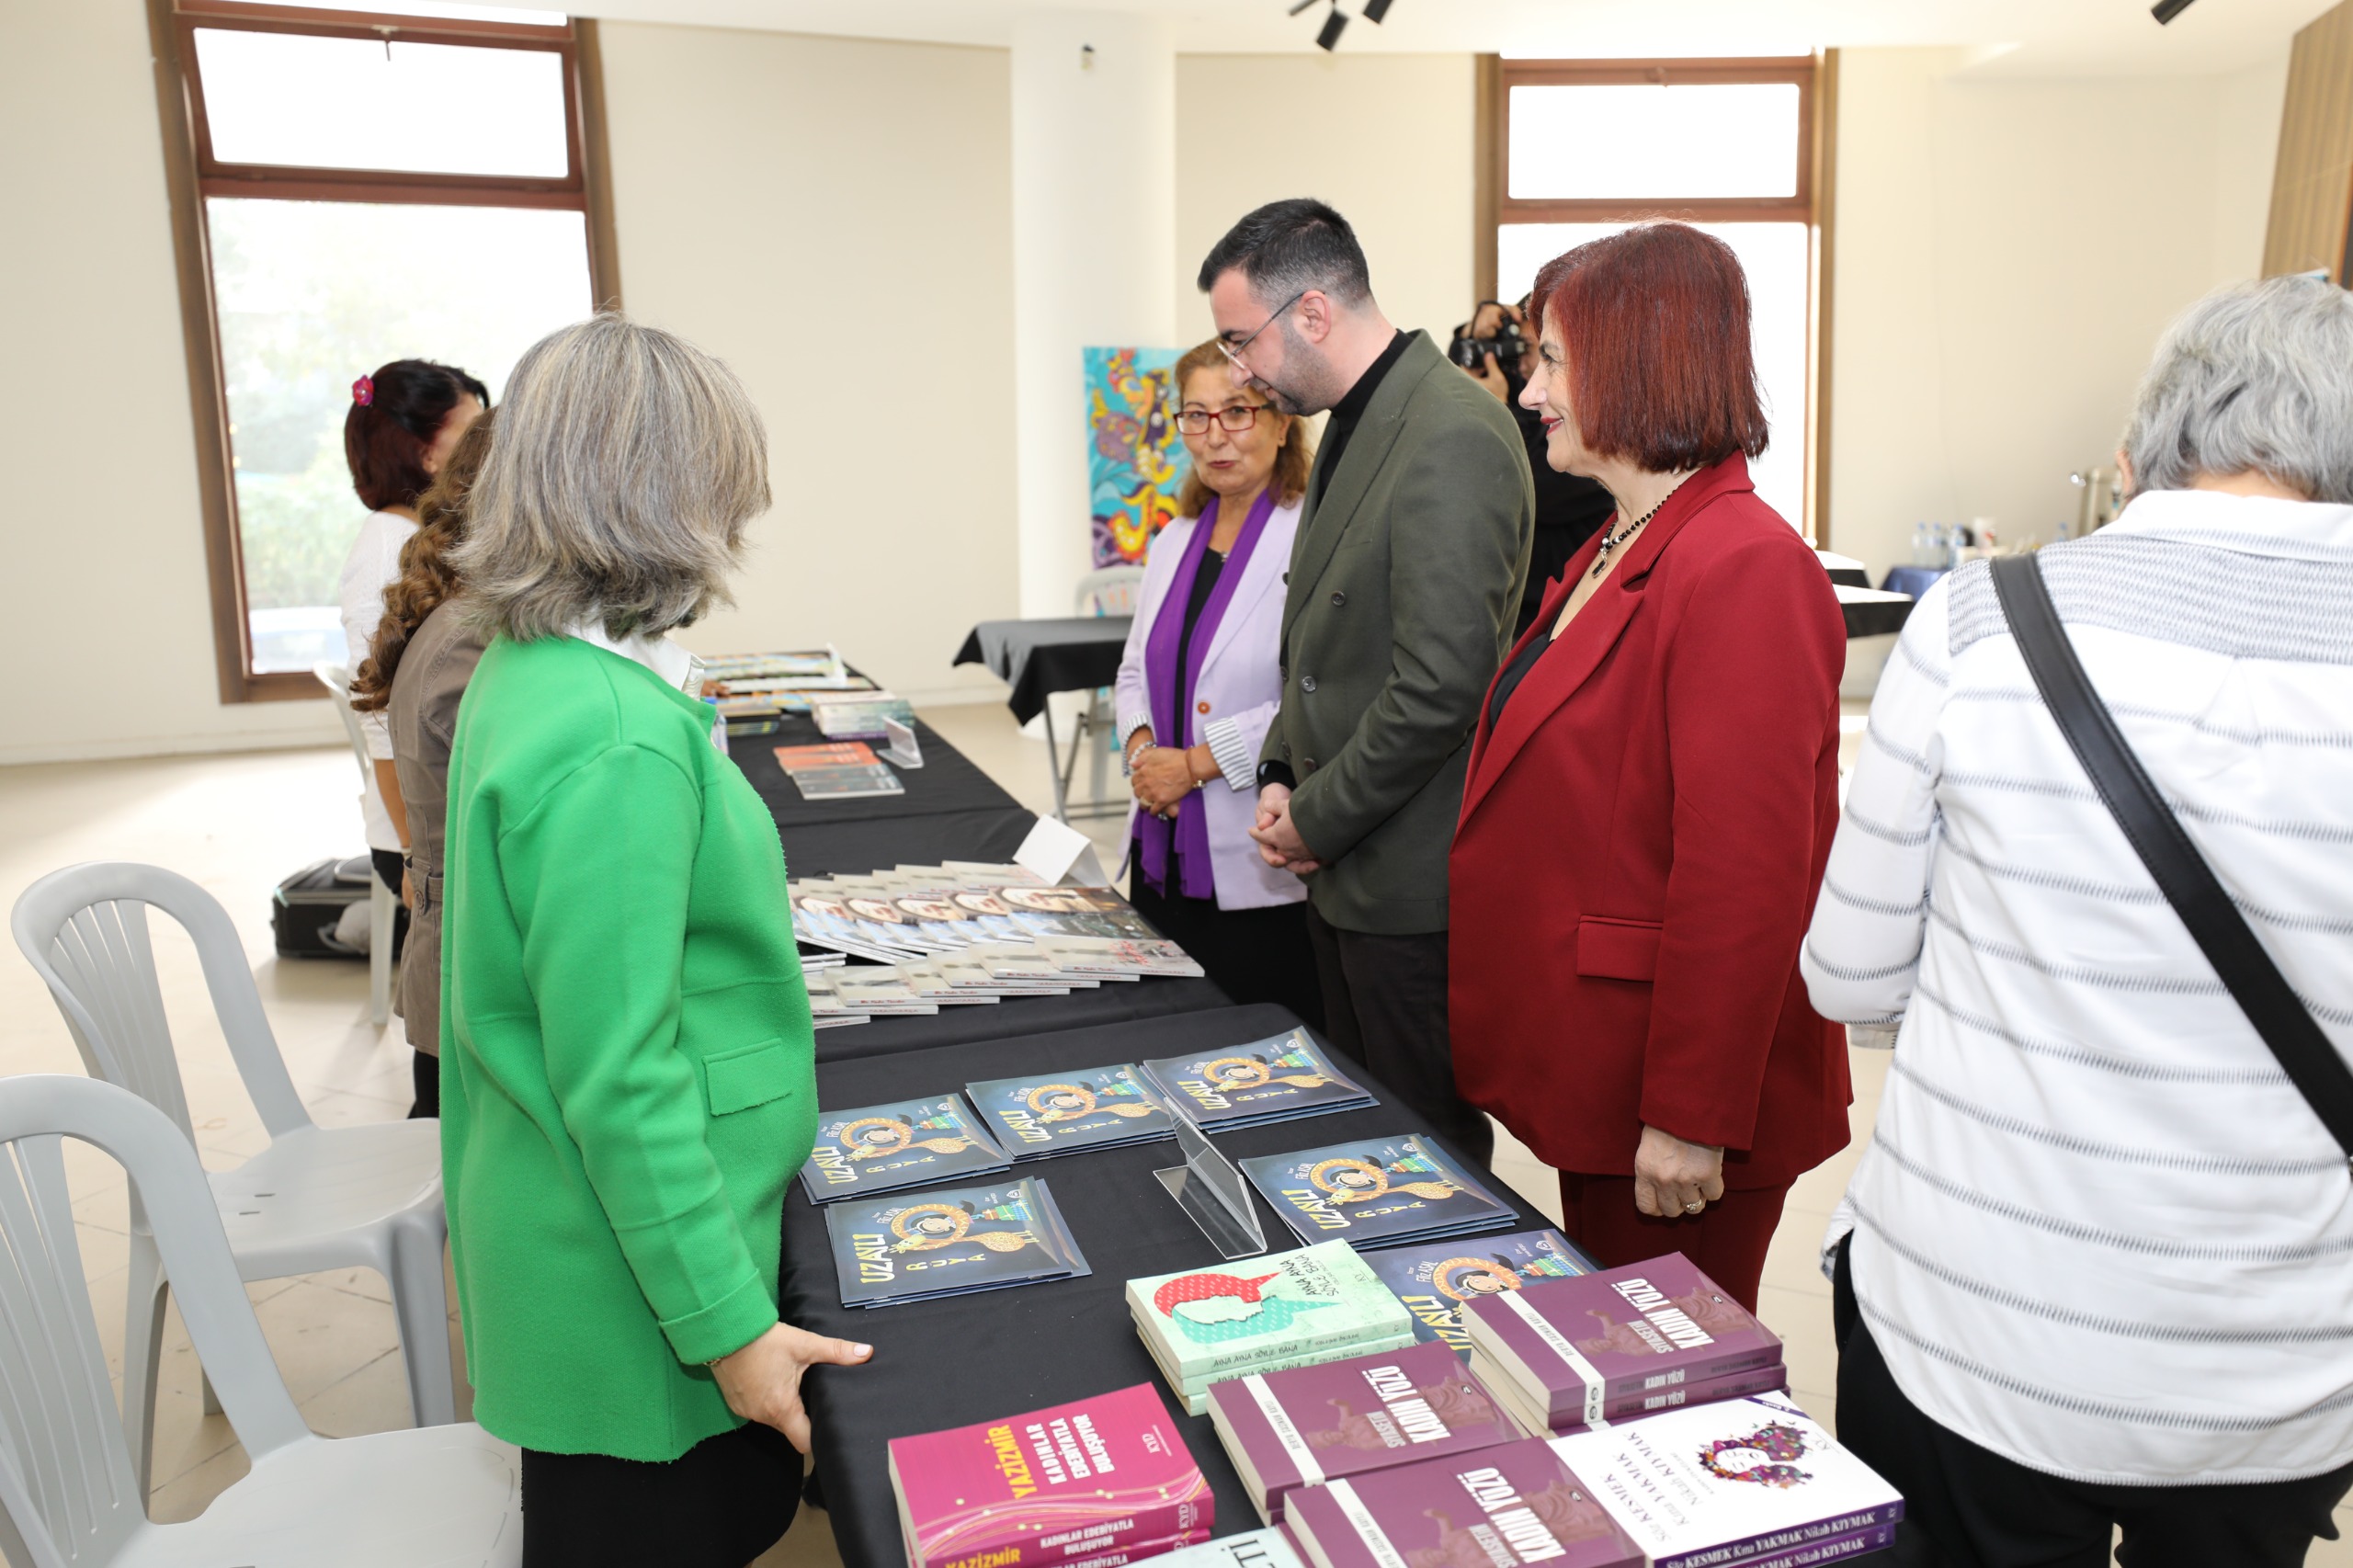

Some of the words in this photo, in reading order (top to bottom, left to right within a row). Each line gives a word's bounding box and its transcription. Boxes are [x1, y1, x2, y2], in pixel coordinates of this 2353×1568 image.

[1177, 1080, 1232, 1110] UZAYLI
[999, 1110, 1052, 1143] UZAYLI
[812, 1146, 858, 1185] UZAYLI
[1281, 1188, 1351, 1230] UZAYLI
[852, 1233, 895, 1284] UZAYLI
[1279, 1260, 1305, 1277] AYNA
[1294, 1254, 1319, 1273] BANA
[1296, 1278, 1322, 1295] AYNA
[1610, 1278, 1671, 1313] YÜZÜ
[1644, 1307, 1715, 1350] KADIN
[1361, 1365, 1418, 1403] YÜZÜ
[1644, 1372, 1667, 1390] KADIN
[1667, 1368, 1686, 1383] YÜZÜ
[1644, 1393, 1667, 1410] KADIN
[1667, 1389, 1686, 1406] YÜZÜ
[1386, 1398, 1451, 1444] KADIN
[983, 1424, 1038, 1500] YAZİZMİR
[1026, 1423, 1067, 1484] KADINLAR
[1049, 1417, 1092, 1479] EDEBİYATLA
[1073, 1414, 1115, 1474] BULUŞUYOR
[1623, 1431, 1675, 1477] KIYMAK
[1456, 1467, 1523, 1514] YÜZÜ
[1612, 1452, 1665, 1502] YAKMAK
[1040, 1528, 1083, 1549] KADINLAR
[1083, 1518, 1134, 1541] EDEBİYATLA
[1063, 1535, 1114, 1557] BULUŞUYOR
[1489, 1506, 1567, 1564] KADIN
[1755, 1528, 1803, 1551] YAKMAK
[1803, 1525, 1830, 1540] Nikah
[1830, 1511, 1875, 1533] KIYMAK
[1821, 1537, 1866, 1559] KIYMAK
